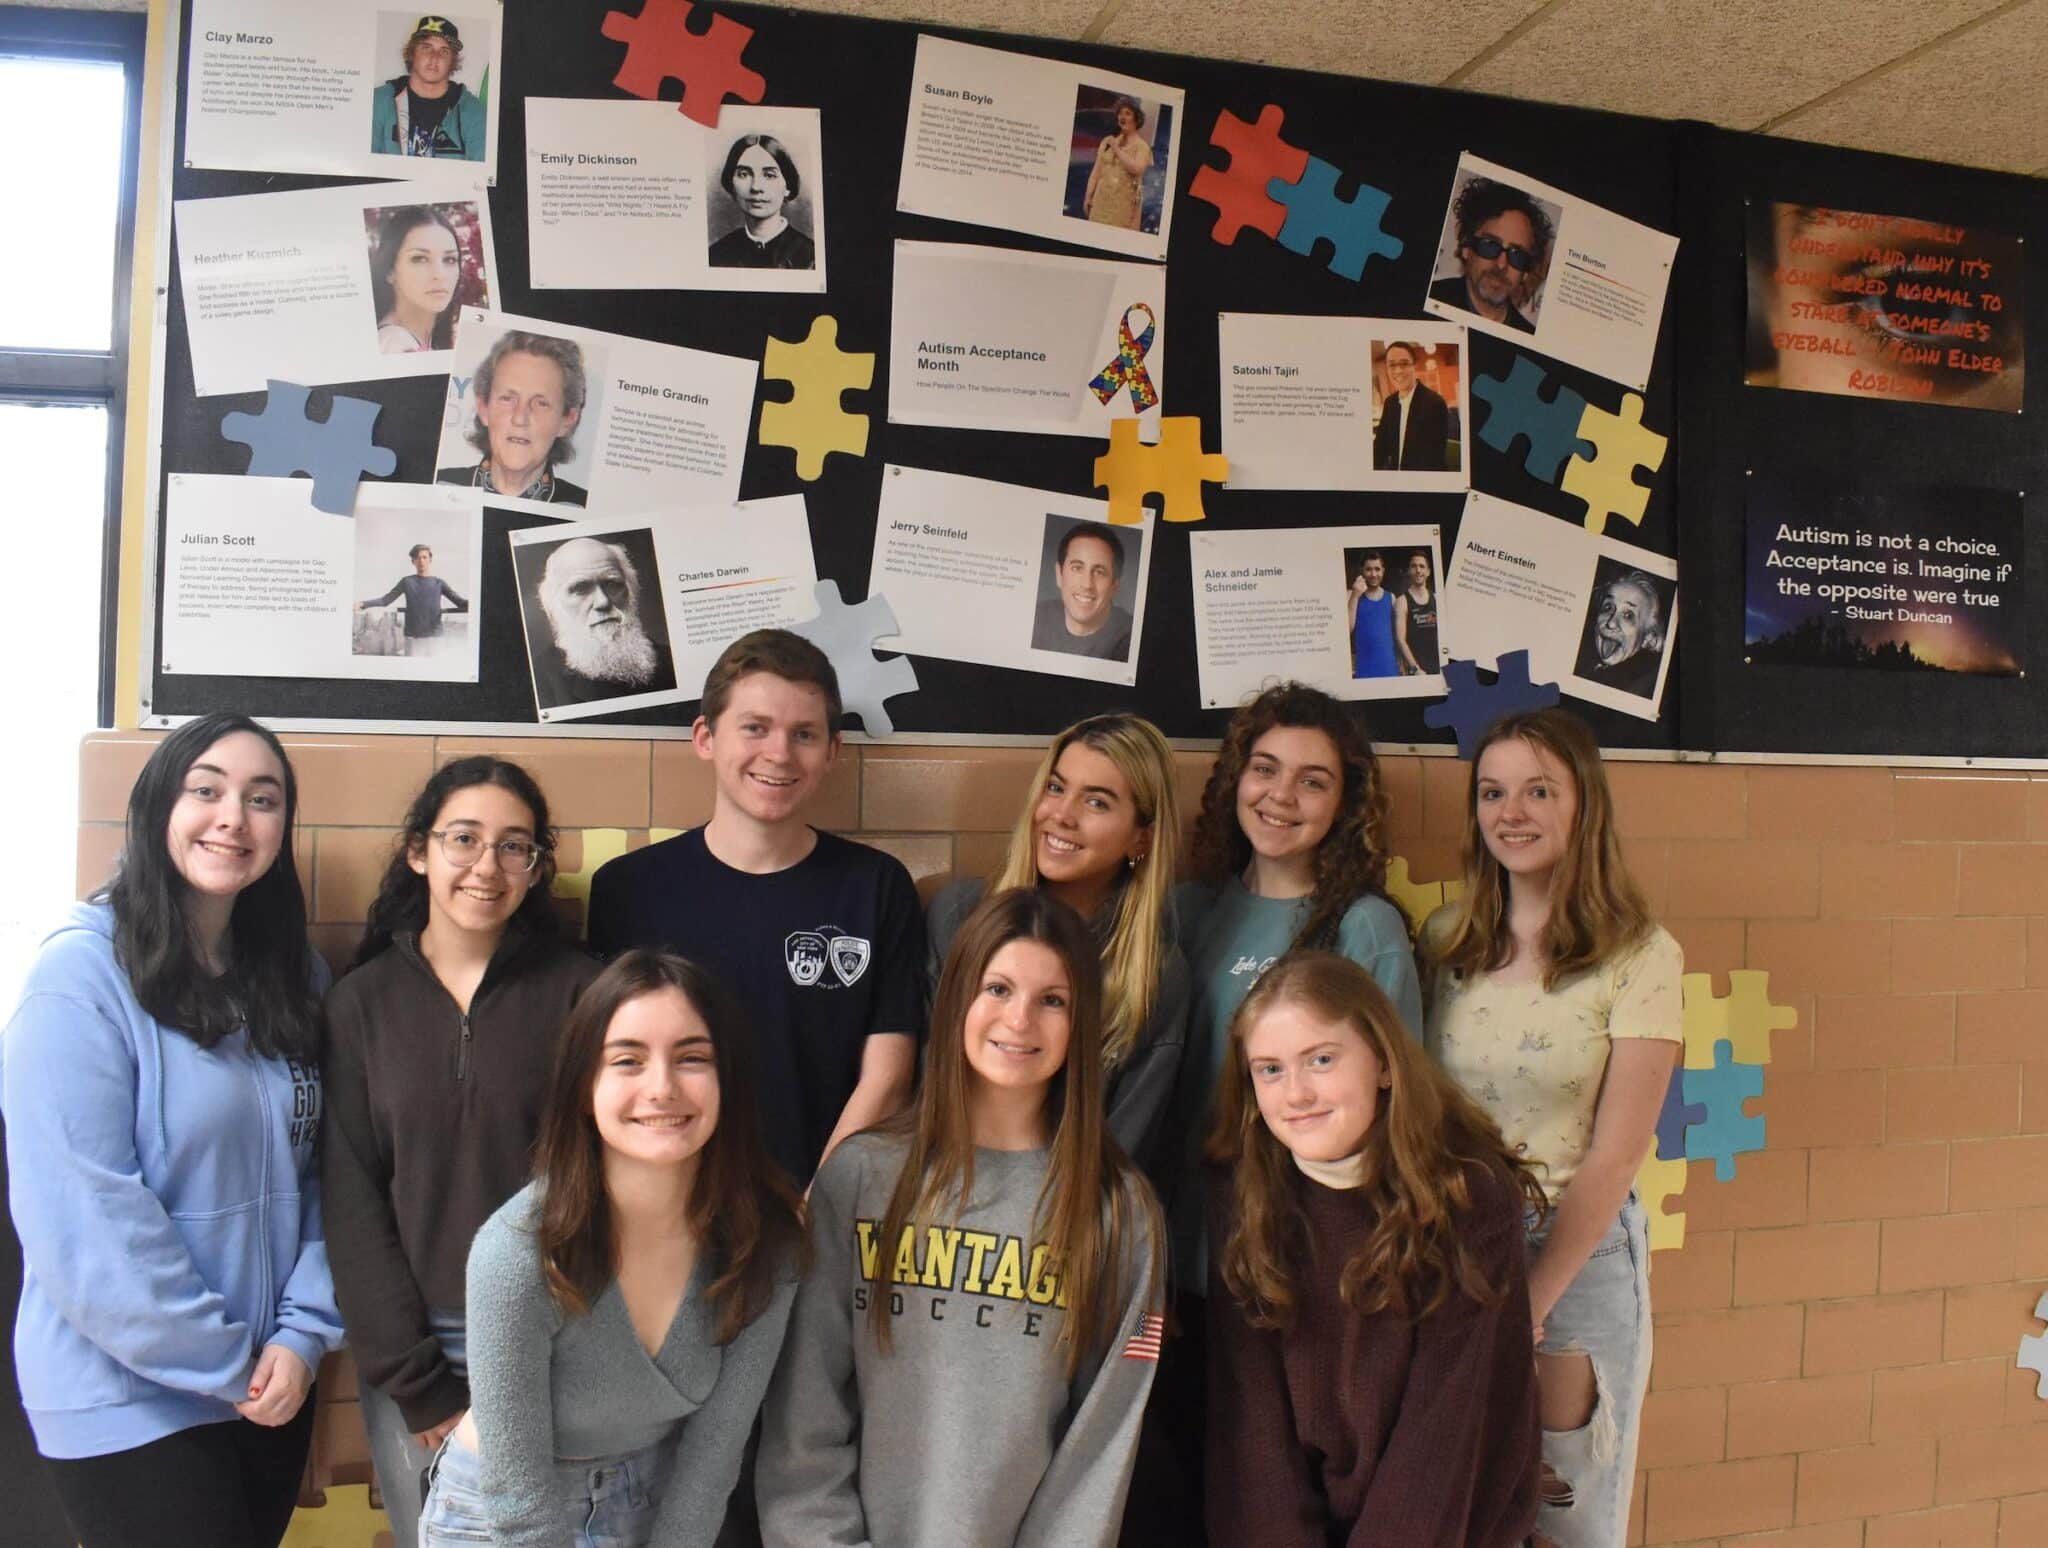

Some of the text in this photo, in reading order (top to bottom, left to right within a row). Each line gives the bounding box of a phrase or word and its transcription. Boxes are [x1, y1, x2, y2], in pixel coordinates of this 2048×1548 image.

[206, 31, 273, 45] Clay Marzo
[924, 84, 993, 105] Susan Boyle
[541, 153, 637, 166] Emily Dickinson
[194, 252, 244, 265] Heather
[1568, 249, 1606, 270] Tim Burton
[1914, 254, 1954, 272] WHY
[1959, 259, 1992, 279] IT'S
[1896, 283, 1973, 307] NORMAL
[1980, 294, 2002, 312] TO
[1791, 302, 1992, 342] STARE AT SOMEONE'S
[918, 341, 1046, 361] Autism Acceptance
[1773, 331, 1856, 356] EYEBALL
[1947, 350, 2004, 372] ELDER
[918, 358, 959, 372] Month
[1232, 365, 1299, 378] Satoshi Tajiri
[617, 379, 709, 406] Temple Grandin
[181, 533, 255, 546] Julian Scott
[890, 520, 968, 540] Jerry Seinfeld
[1775, 524, 2000, 557] Autism is not a choice.
[1467, 541, 1536, 570] Albert Einstein
[678, 566, 749, 582] Charles Darwin
[1205, 567, 1283, 579] Alex and Jamie
[1766, 550, 2012, 583] Acceptance is. Imagine if
[1206, 582, 1258, 592] Schneider
[1777, 578, 2000, 607] the opposite were true
[1845, 606, 1894, 621] Stuart
[1898, 608, 1952, 624] Duncan
[855, 1218, 1068, 1310] WANTAG
[855, 1288, 1044, 1337] SOCCE
